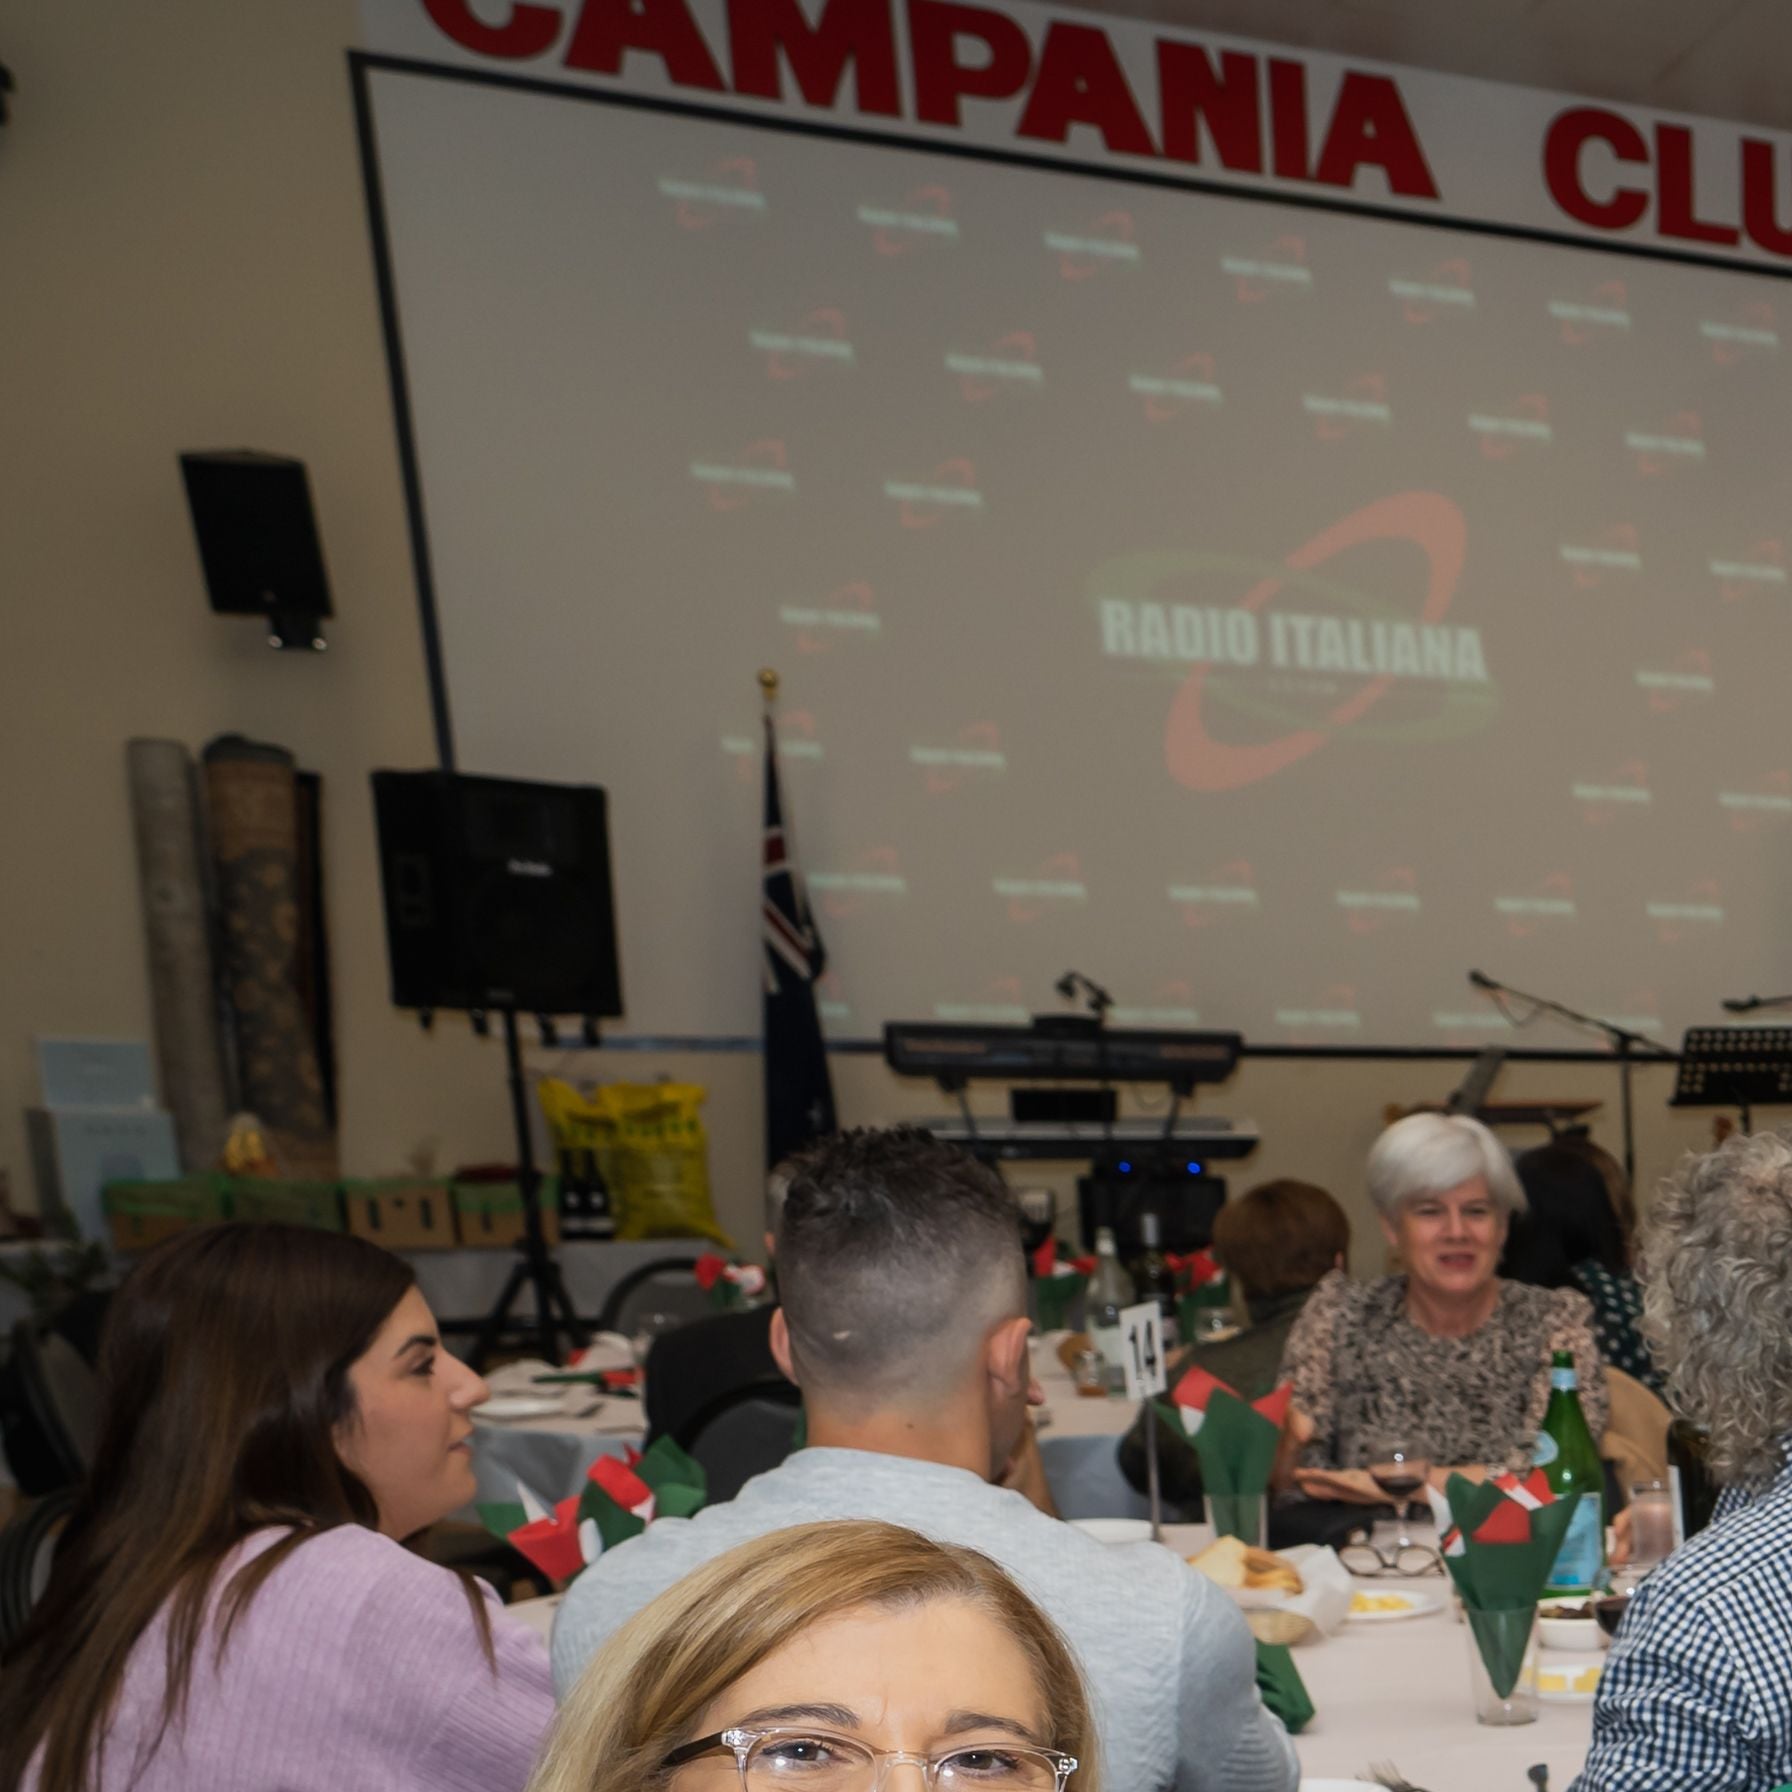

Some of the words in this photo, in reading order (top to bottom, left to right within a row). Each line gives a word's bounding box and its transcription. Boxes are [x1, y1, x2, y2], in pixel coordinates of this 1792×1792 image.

[1100, 600, 1258, 667] RADIO
[1270, 613, 1488, 682] ITALIANA
[1129, 1319, 1157, 1380] 14
